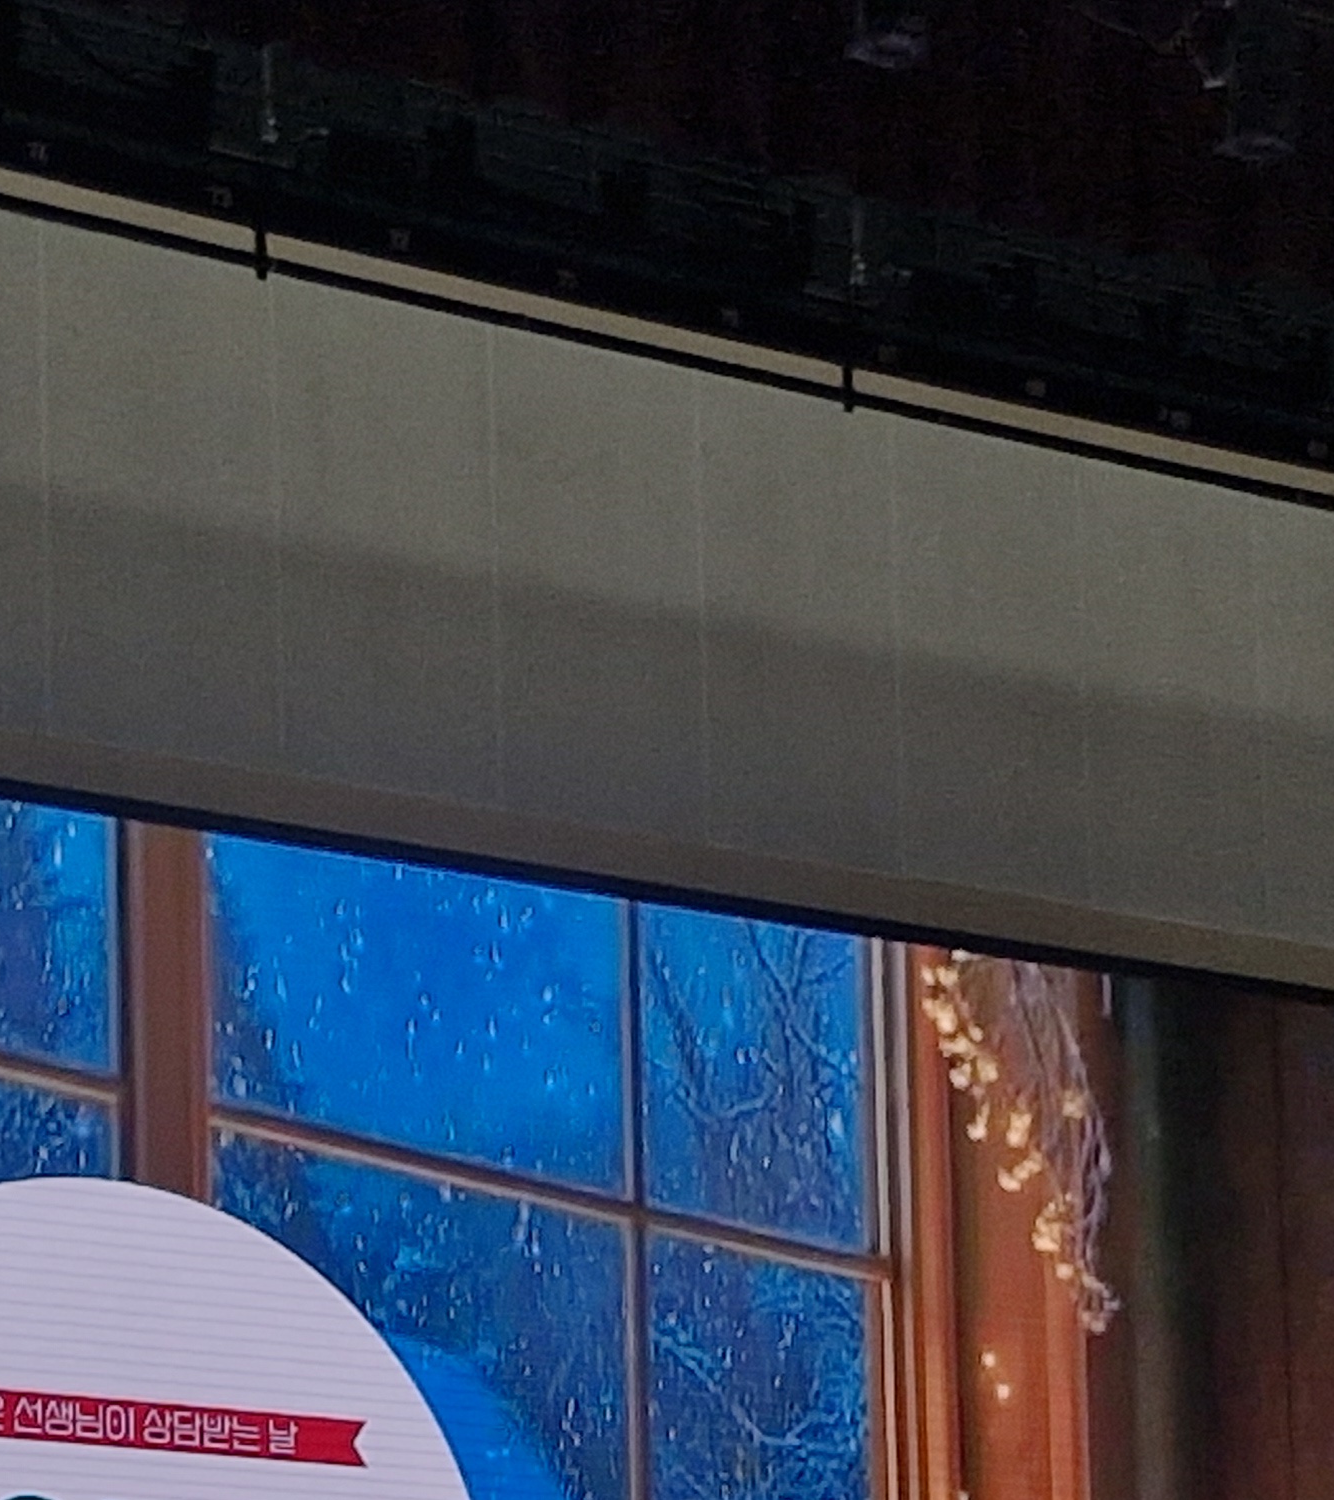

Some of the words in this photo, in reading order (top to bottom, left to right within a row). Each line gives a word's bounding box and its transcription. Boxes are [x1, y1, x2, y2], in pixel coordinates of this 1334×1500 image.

[13, 1397, 136, 1443] 선생님이
[142, 1409, 266, 1453] 상담받는
[269, 1419, 299, 1456] 날
